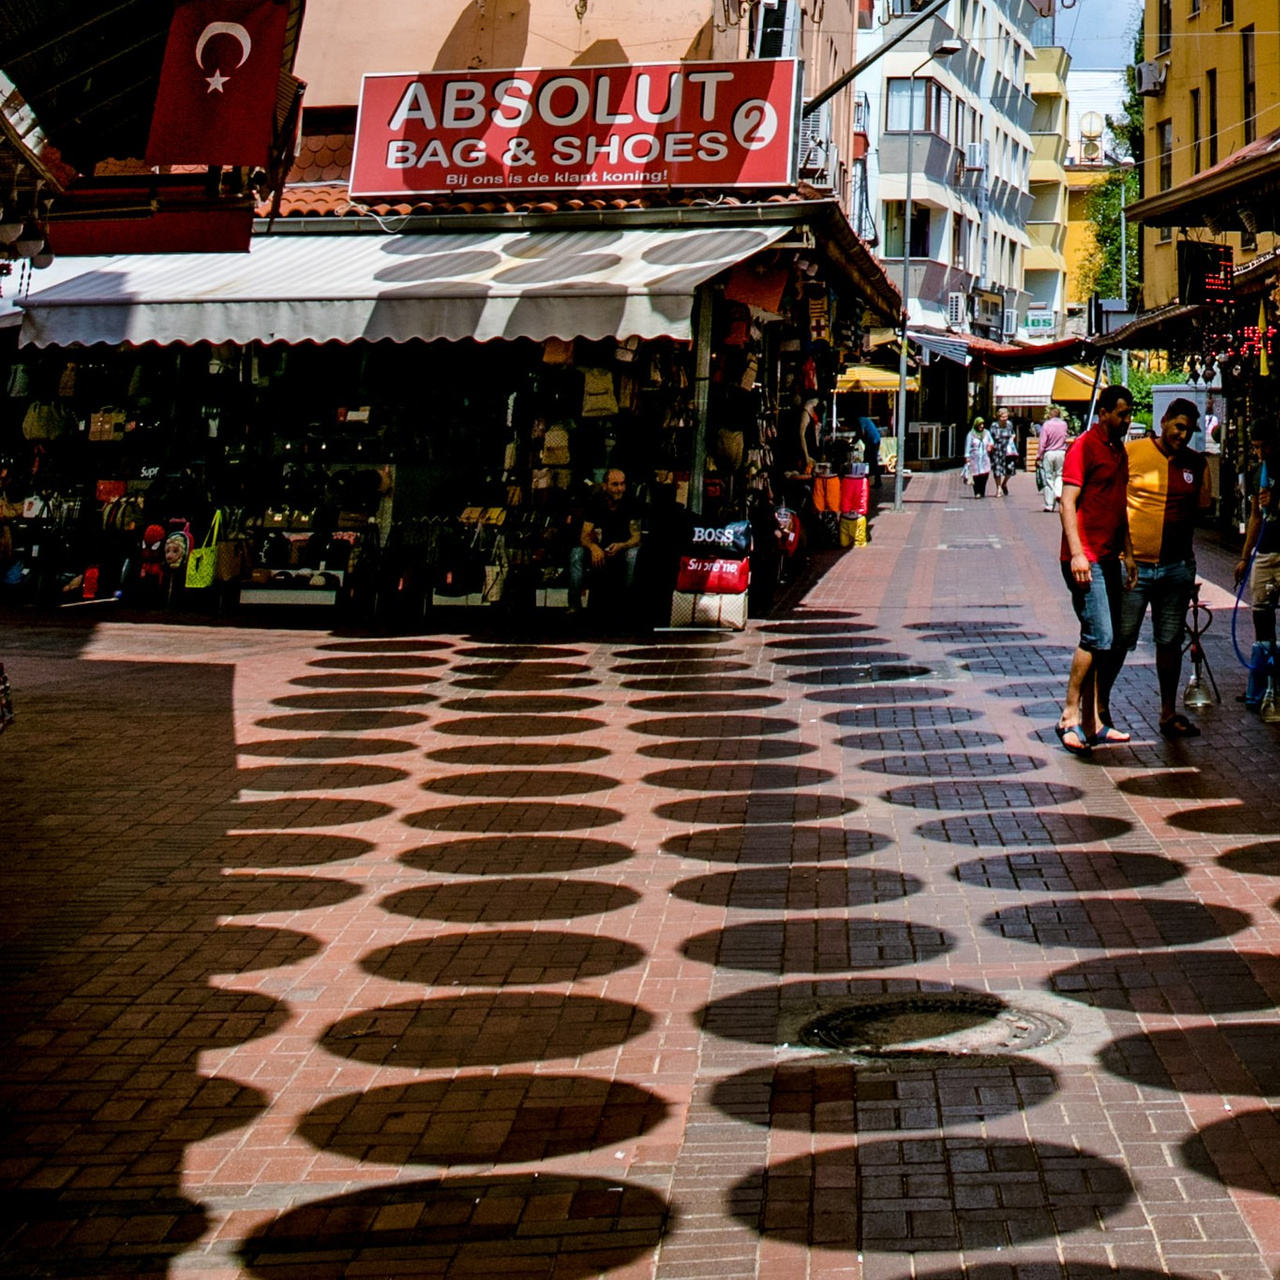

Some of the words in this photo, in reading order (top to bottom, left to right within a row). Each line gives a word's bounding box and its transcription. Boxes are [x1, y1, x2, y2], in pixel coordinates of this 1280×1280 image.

[388, 71, 735, 131] ABSOLUT
[742, 105, 767, 143] 2
[386, 138, 487, 170] BAG
[502, 136, 536, 167] &
[552, 130, 729, 165] SHOES
[446, 174, 468, 187] Bij
[472, 175, 503, 184] ons
[508, 173, 523, 184] is
[527, 172, 549, 183] de
[554, 171, 598, 183] klant
[602, 170, 668, 183] koning!
[692, 527, 734, 543] BOSS
